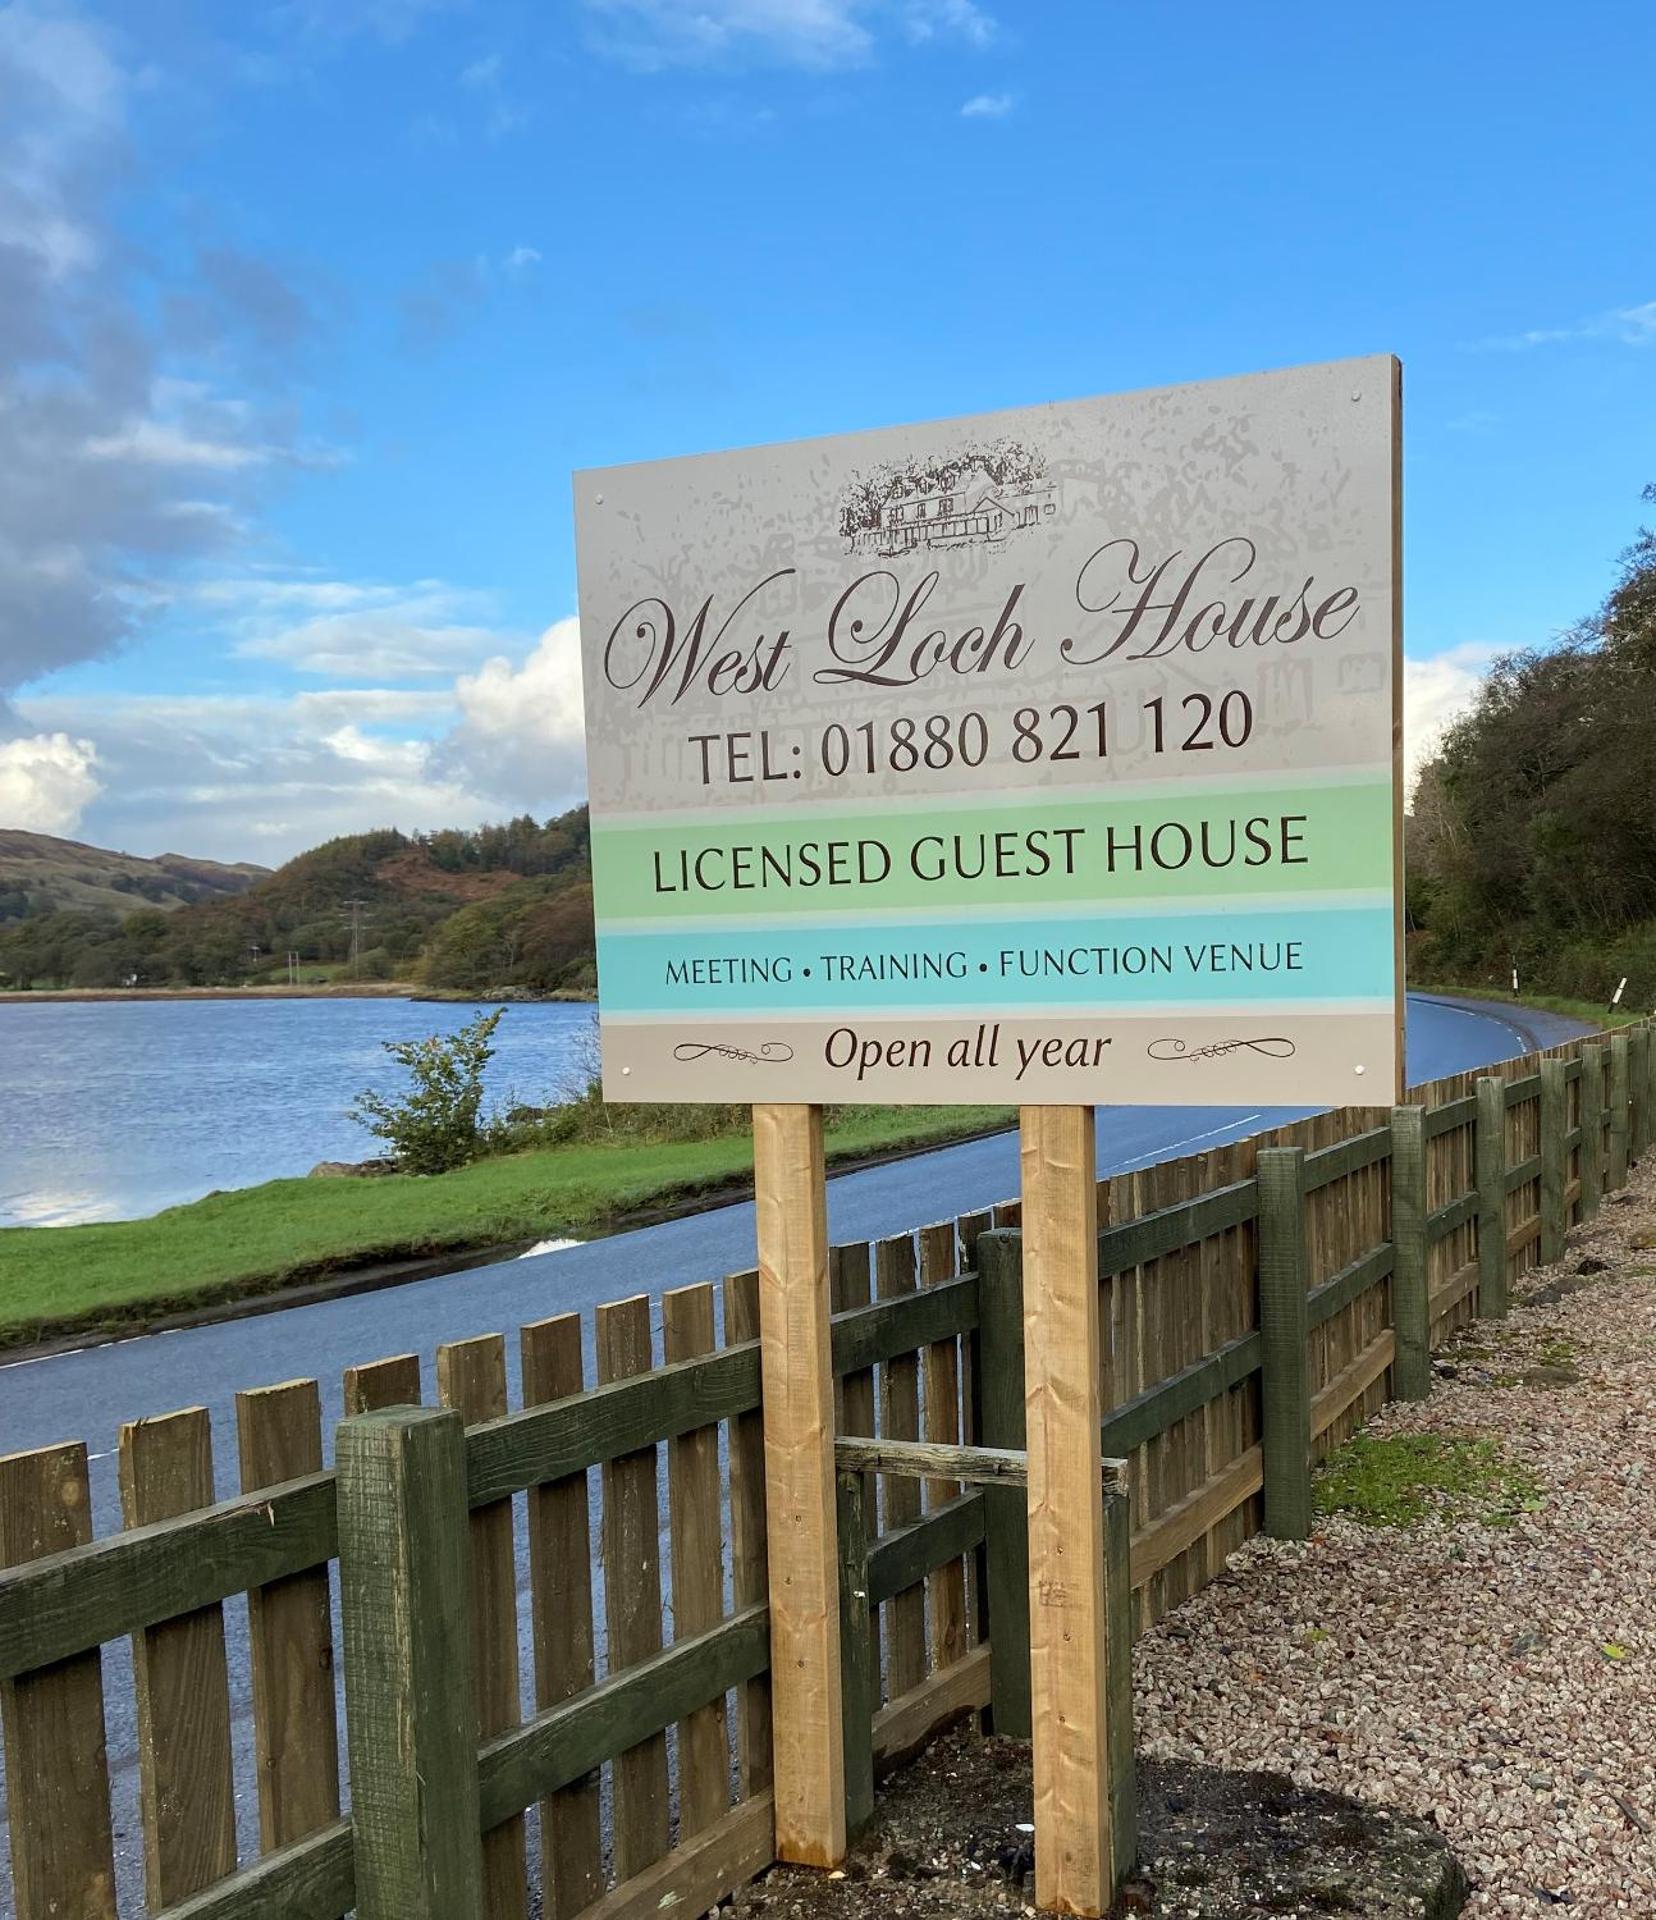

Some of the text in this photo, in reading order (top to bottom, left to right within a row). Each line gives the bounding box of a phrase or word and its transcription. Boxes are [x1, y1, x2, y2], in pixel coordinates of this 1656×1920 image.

[603, 537, 1361, 709] West Loch House
[687, 689, 1253, 785] TEL: 01880 821 120
[653, 814, 1309, 893] LICENSED GUEST HOUSE
[665, 941, 1303, 985] MEETING TRAINING FUNCTION VENUE
[824, 1023, 1113, 1081] Open all year
